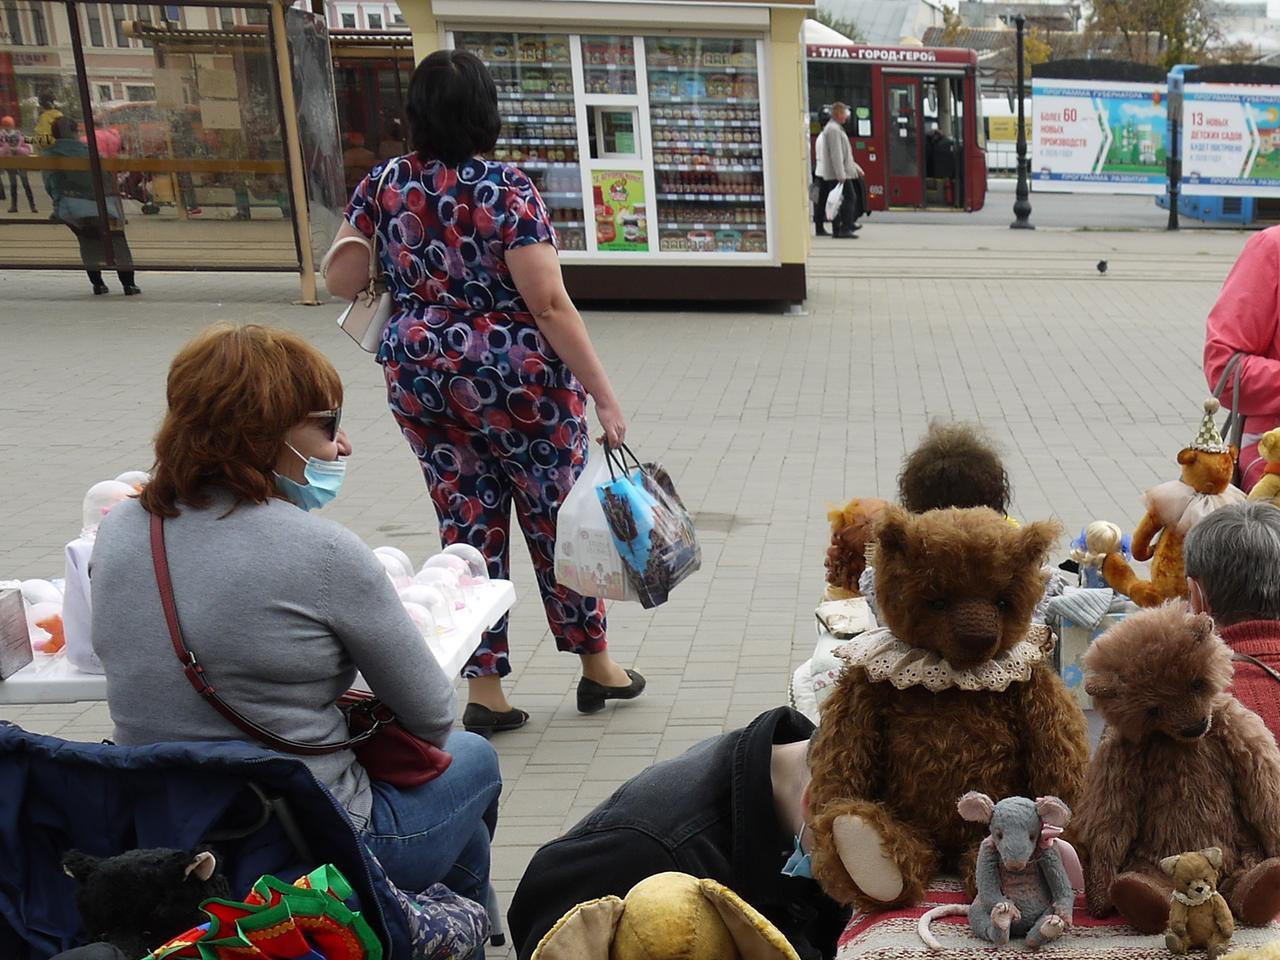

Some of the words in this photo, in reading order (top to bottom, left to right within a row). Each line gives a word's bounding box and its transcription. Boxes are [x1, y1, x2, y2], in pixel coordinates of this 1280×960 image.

[819, 48, 850, 58] ТУЛА
[858, 49, 936, 62] ГОРОД-ГЕРОЙ
[1040, 112, 1061, 121] БОЛЕЕ
[1063, 108, 1077, 122] 60
[1192, 112, 1204, 126] 13
[1206, 118, 1229, 126] НОВЫХ
[1040, 125, 1064, 134] НОВЫХ
[1040, 137, 1087, 147] ПРОИЗВОДСТВ
[1190, 131, 1220, 141] ДЕТСКИХ
[1221, 132, 1243, 141] САДОВ
